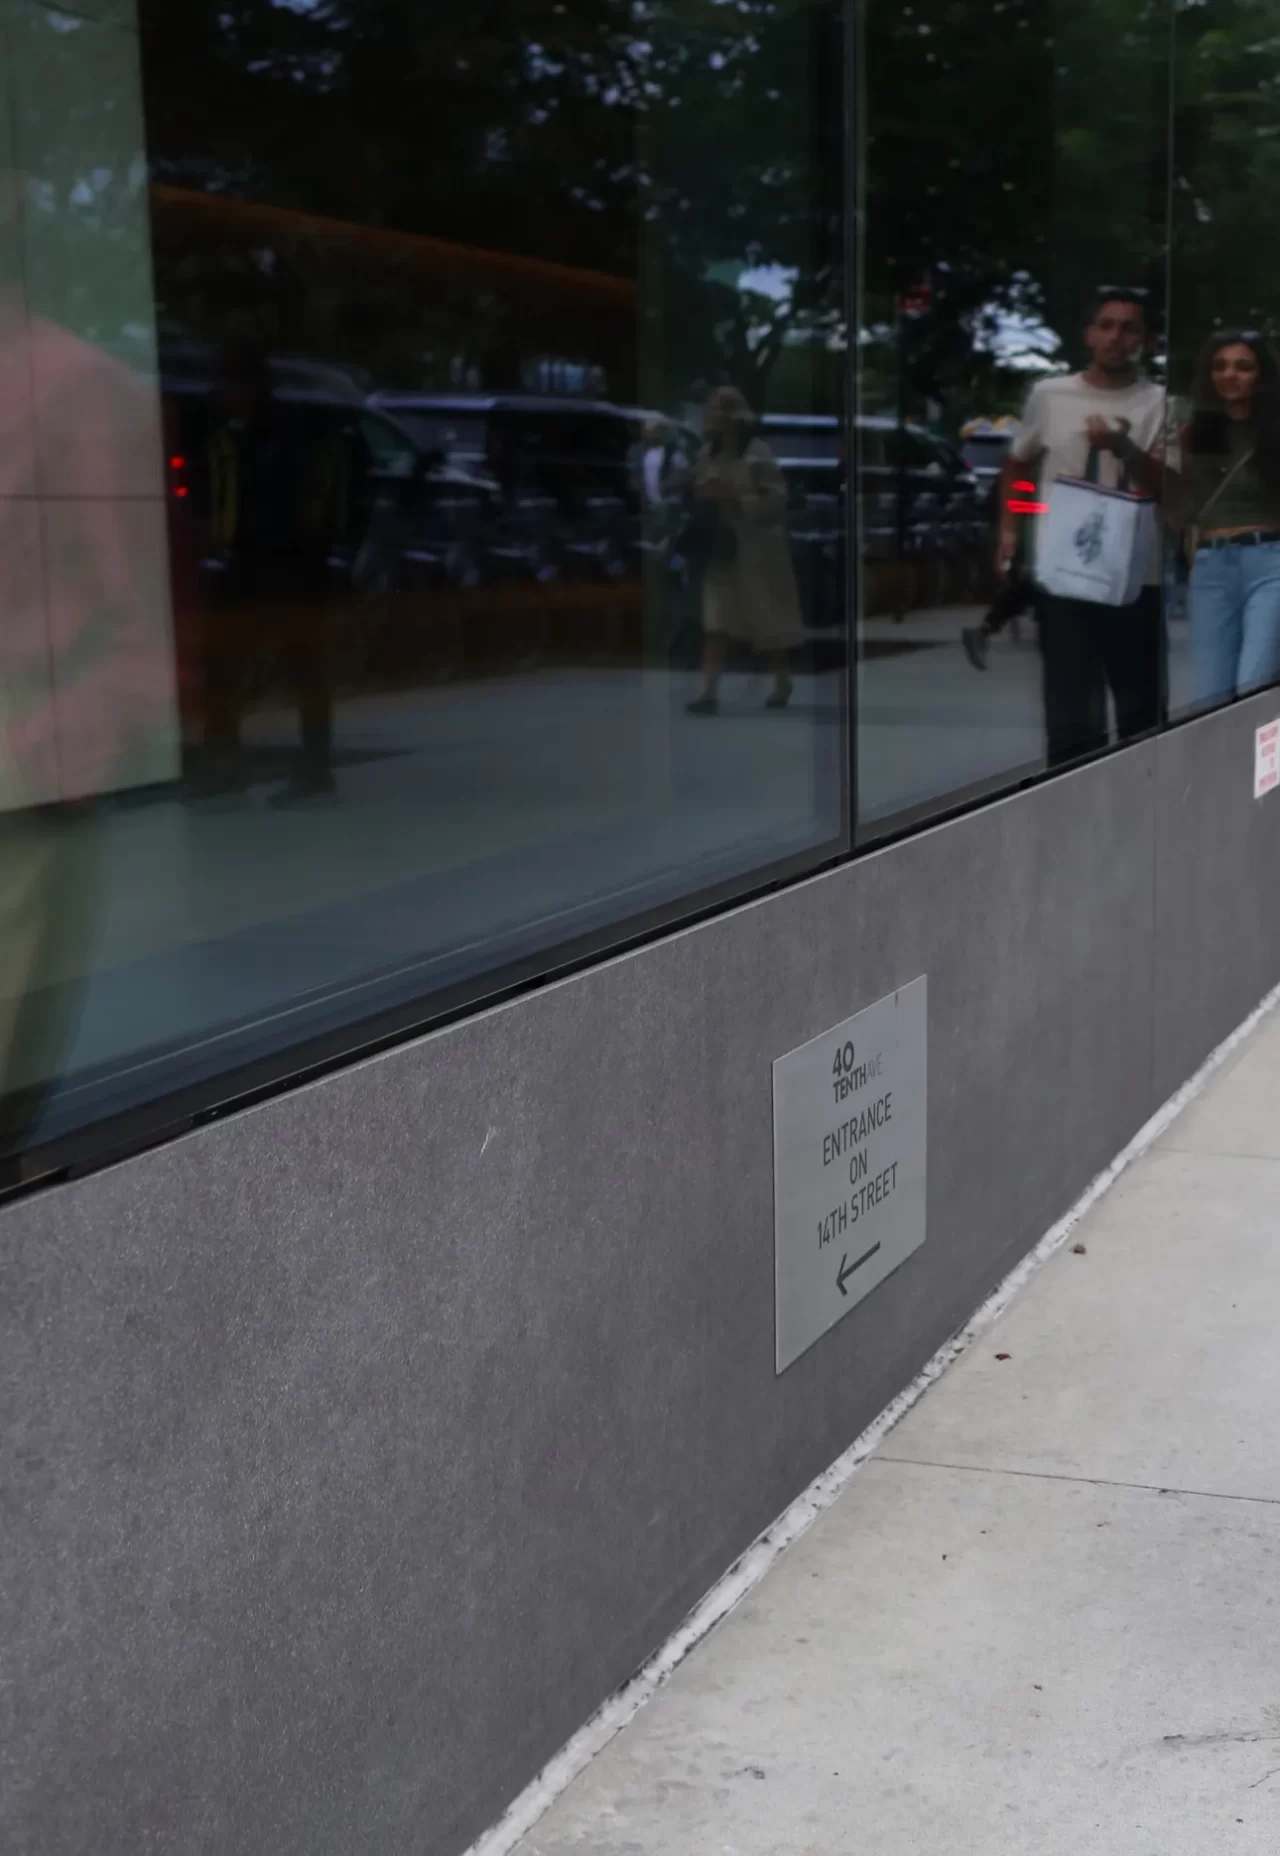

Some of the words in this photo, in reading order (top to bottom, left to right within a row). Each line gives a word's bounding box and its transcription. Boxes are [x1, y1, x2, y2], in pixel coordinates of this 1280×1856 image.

[832, 1040, 855, 1078] 40
[832, 1063, 866, 1104] TENTH
[823, 1092, 892, 1167] ENTRANCE
[849, 1148, 867, 1185] ON
[817, 1202, 847, 1250] 14TH
[851, 1161, 898, 1224] STREET
